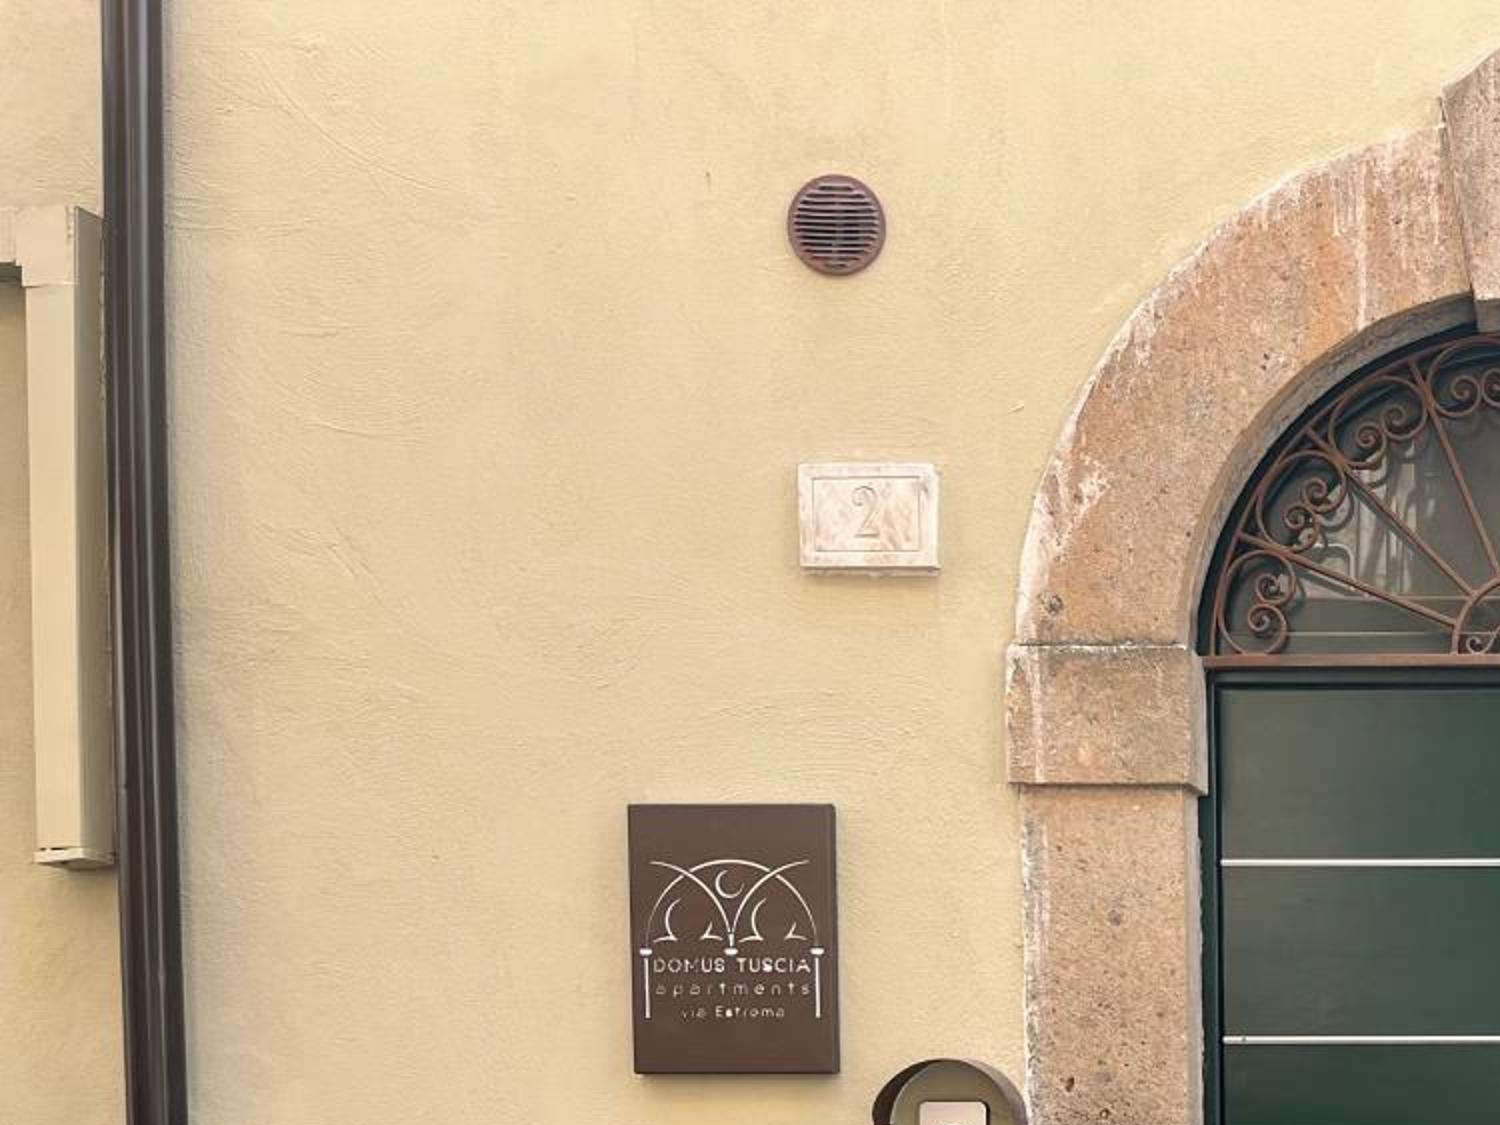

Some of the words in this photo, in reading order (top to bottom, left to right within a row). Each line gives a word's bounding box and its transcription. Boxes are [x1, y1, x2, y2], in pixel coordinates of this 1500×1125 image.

[852, 485, 880, 538] 2
[652, 956, 726, 974] DOMUS
[735, 956, 812, 974] TUSCIA
[655, 982, 810, 998] apartments
[681, 1006, 707, 1019] via
[714, 1004, 785, 1018] Etroma
